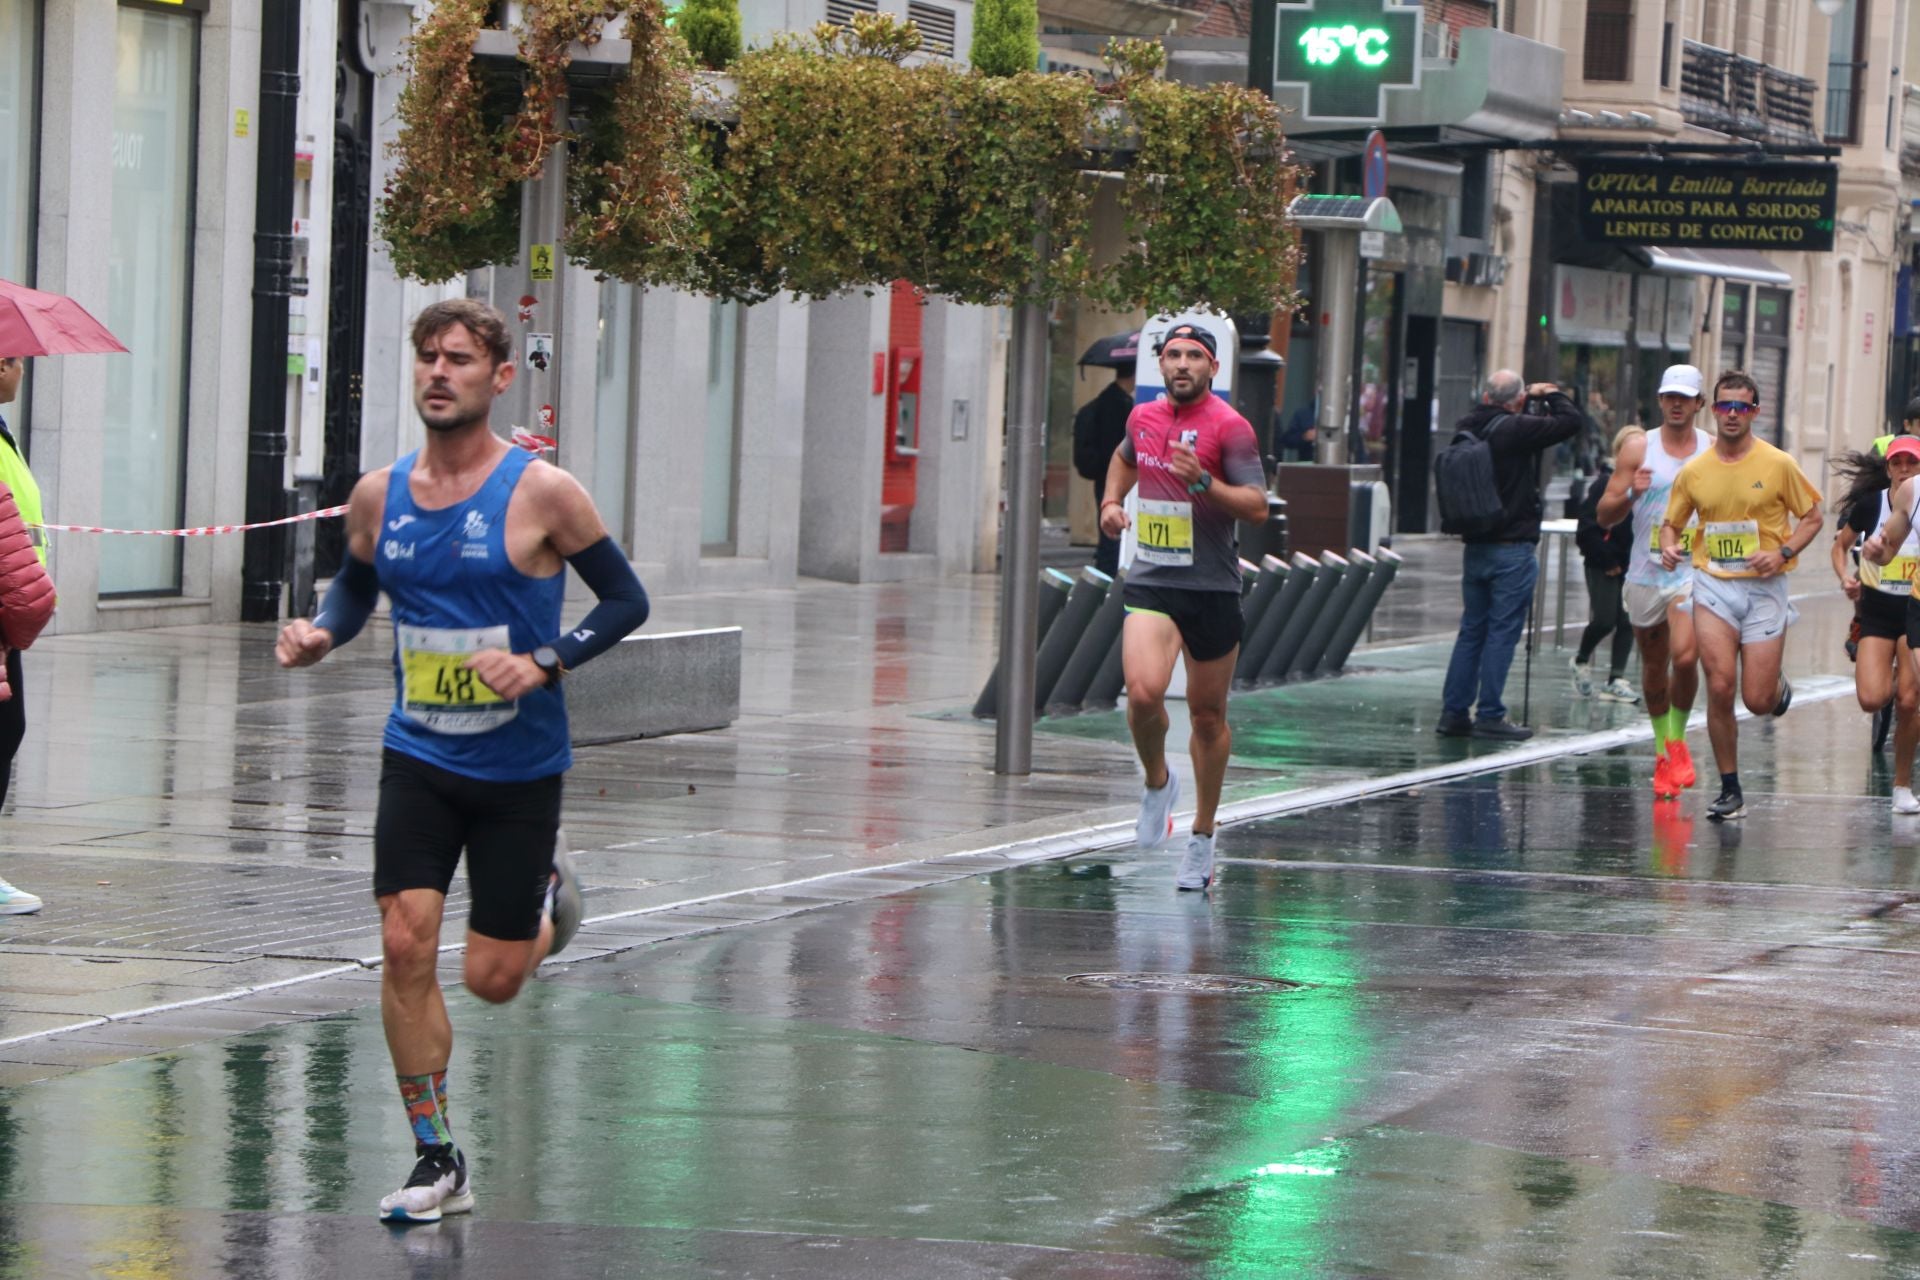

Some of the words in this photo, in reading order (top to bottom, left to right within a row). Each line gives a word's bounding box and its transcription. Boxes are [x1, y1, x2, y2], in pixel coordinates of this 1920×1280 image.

[1587, 173, 1659, 192] OPTICA
[1669, 175, 1734, 194] Emilia
[1742, 177, 1827, 196] Barriada
[1591, 199, 1685, 216] APARATOS
[1691, 202, 1739, 217] PARA
[1747, 203, 1821, 219] SORDOS
[1605, 221, 1671, 238] LENTES
[1679, 223, 1703, 239] DE
[1710, 224, 1803, 241] CONTACTO
[1149, 522, 1170, 546] 171
[1718, 538, 1744, 558] 104
[435, 666, 475, 704] 48
